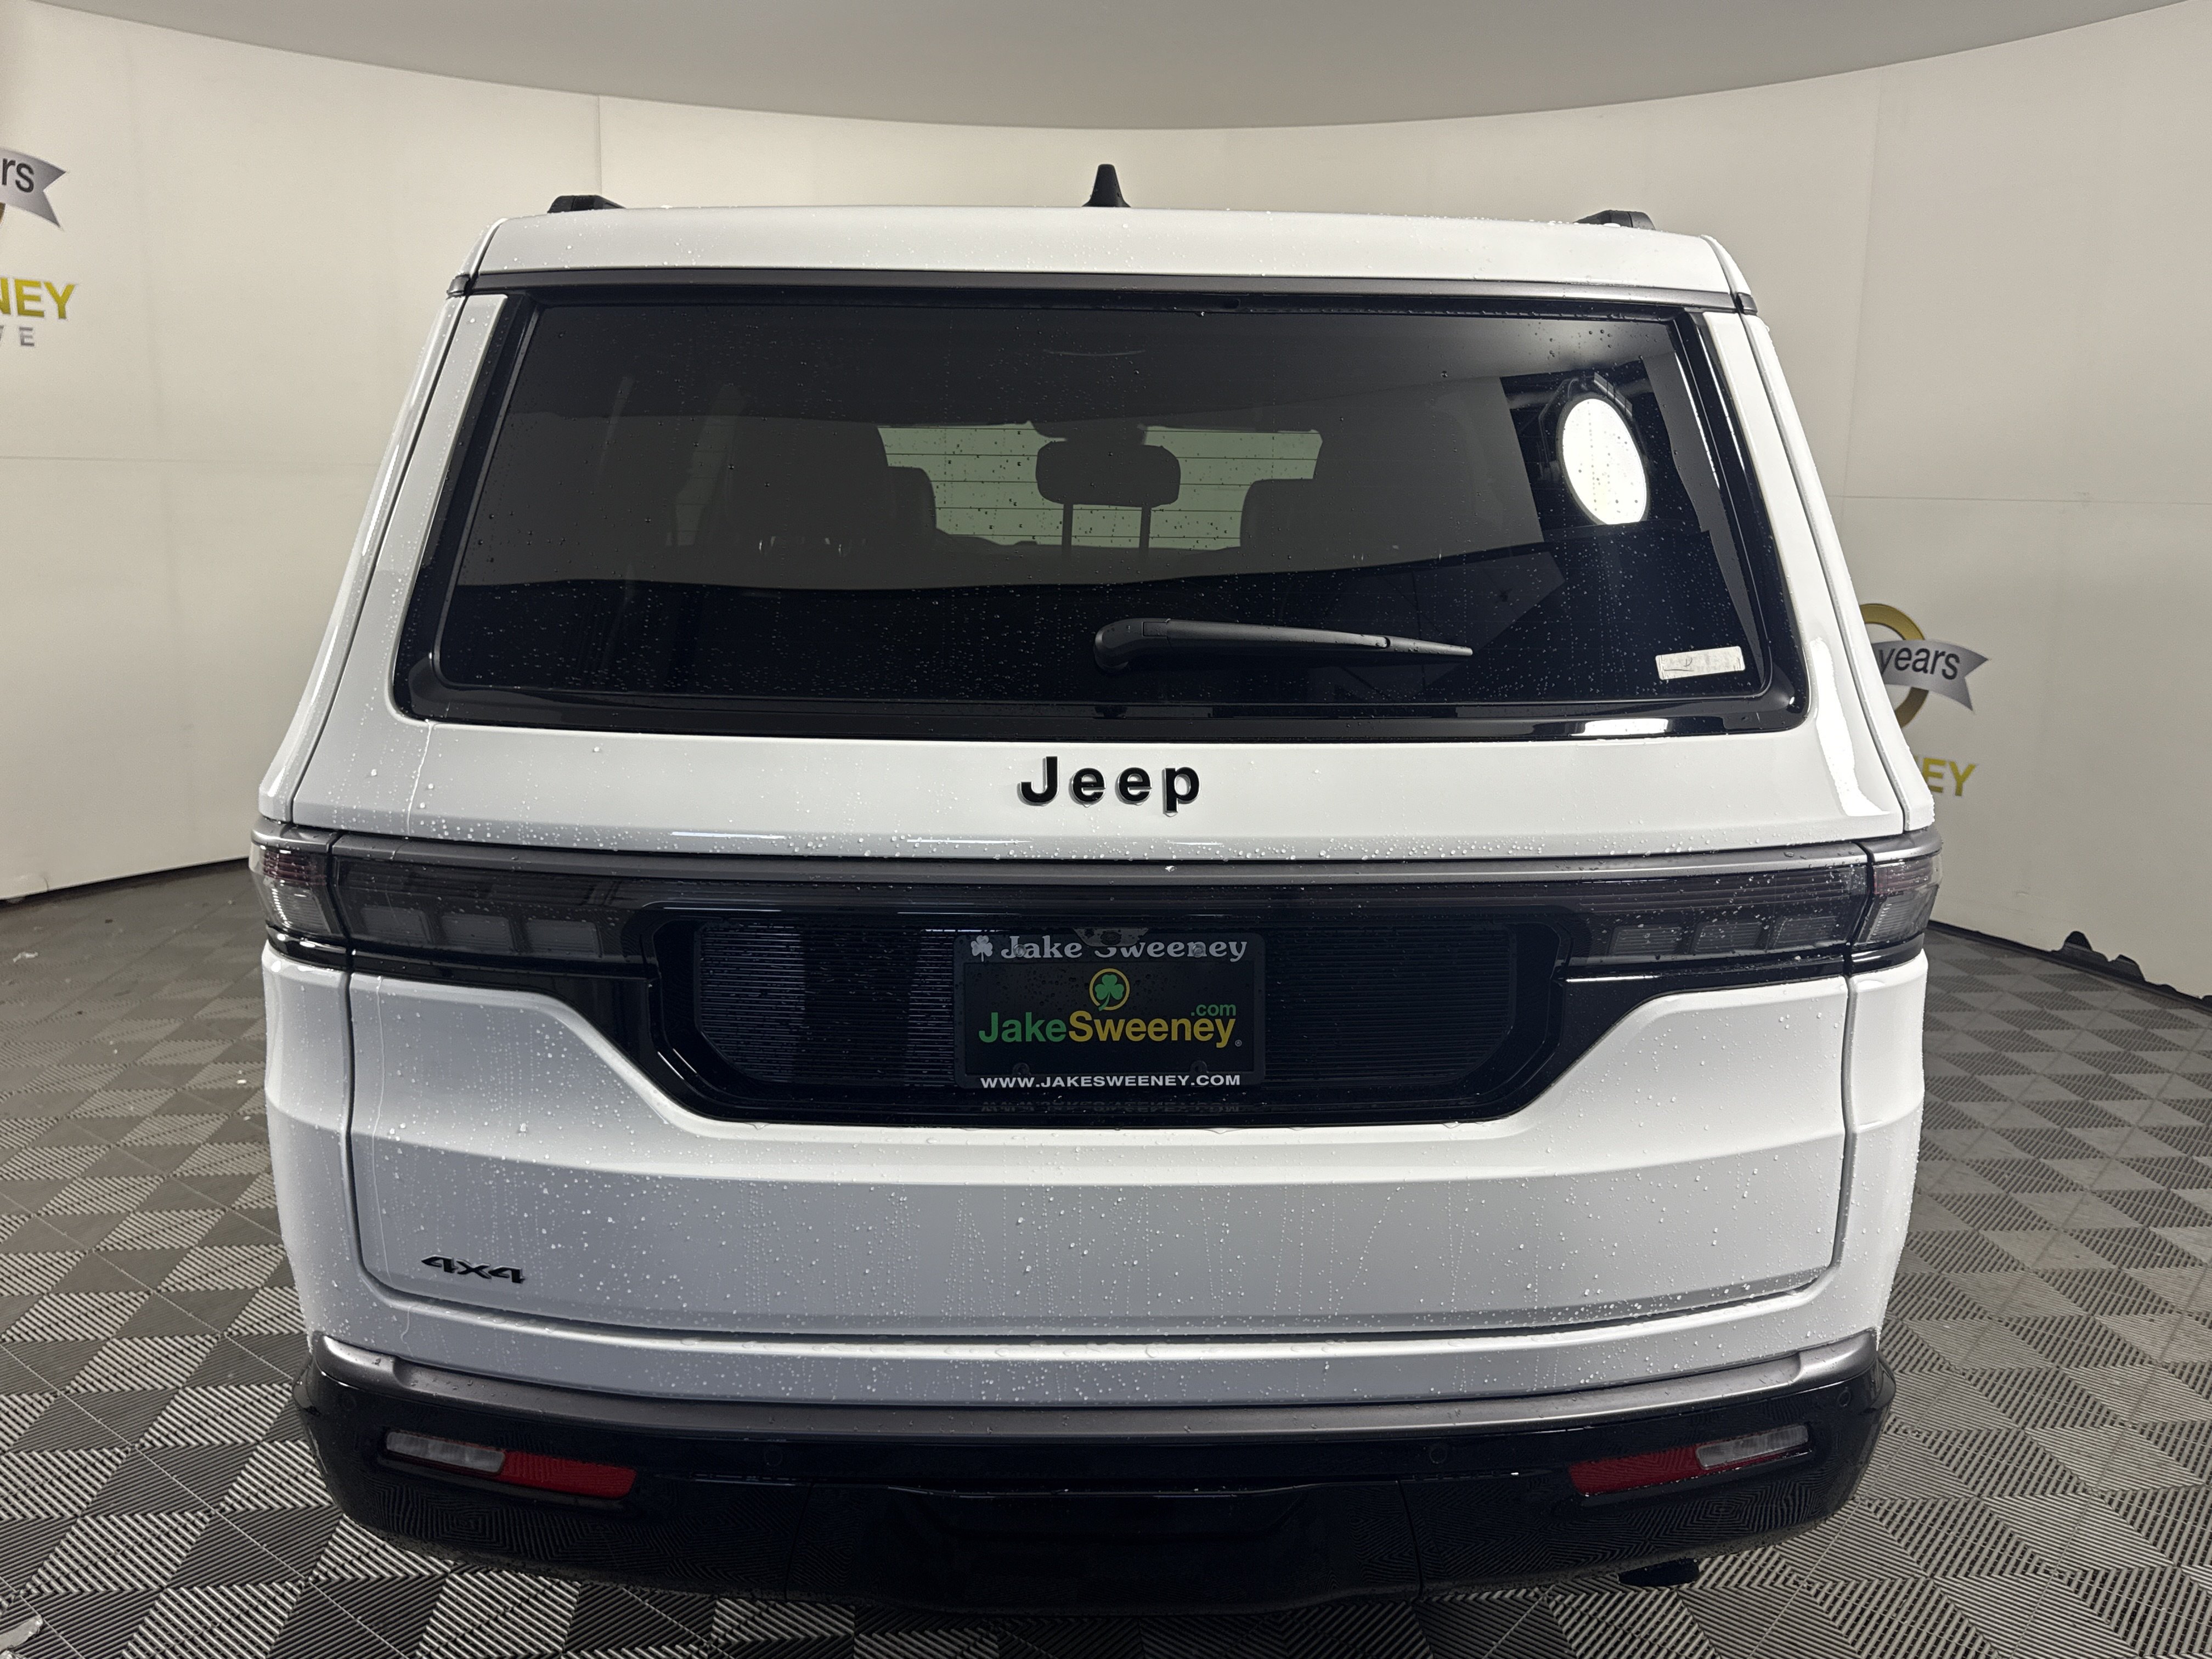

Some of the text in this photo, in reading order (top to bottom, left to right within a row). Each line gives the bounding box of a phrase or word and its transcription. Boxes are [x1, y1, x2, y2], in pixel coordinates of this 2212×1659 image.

[1878, 646, 1960, 680] years
[1018, 755, 1201, 814] Jeep
[1001, 935, 1082, 958] Jake
[1190, 1003, 1236, 1017] .com
[980, 1074, 1240, 1089] WWW.JAKESWEENEY.COM
[421, 1254, 526, 1284] 4x4
